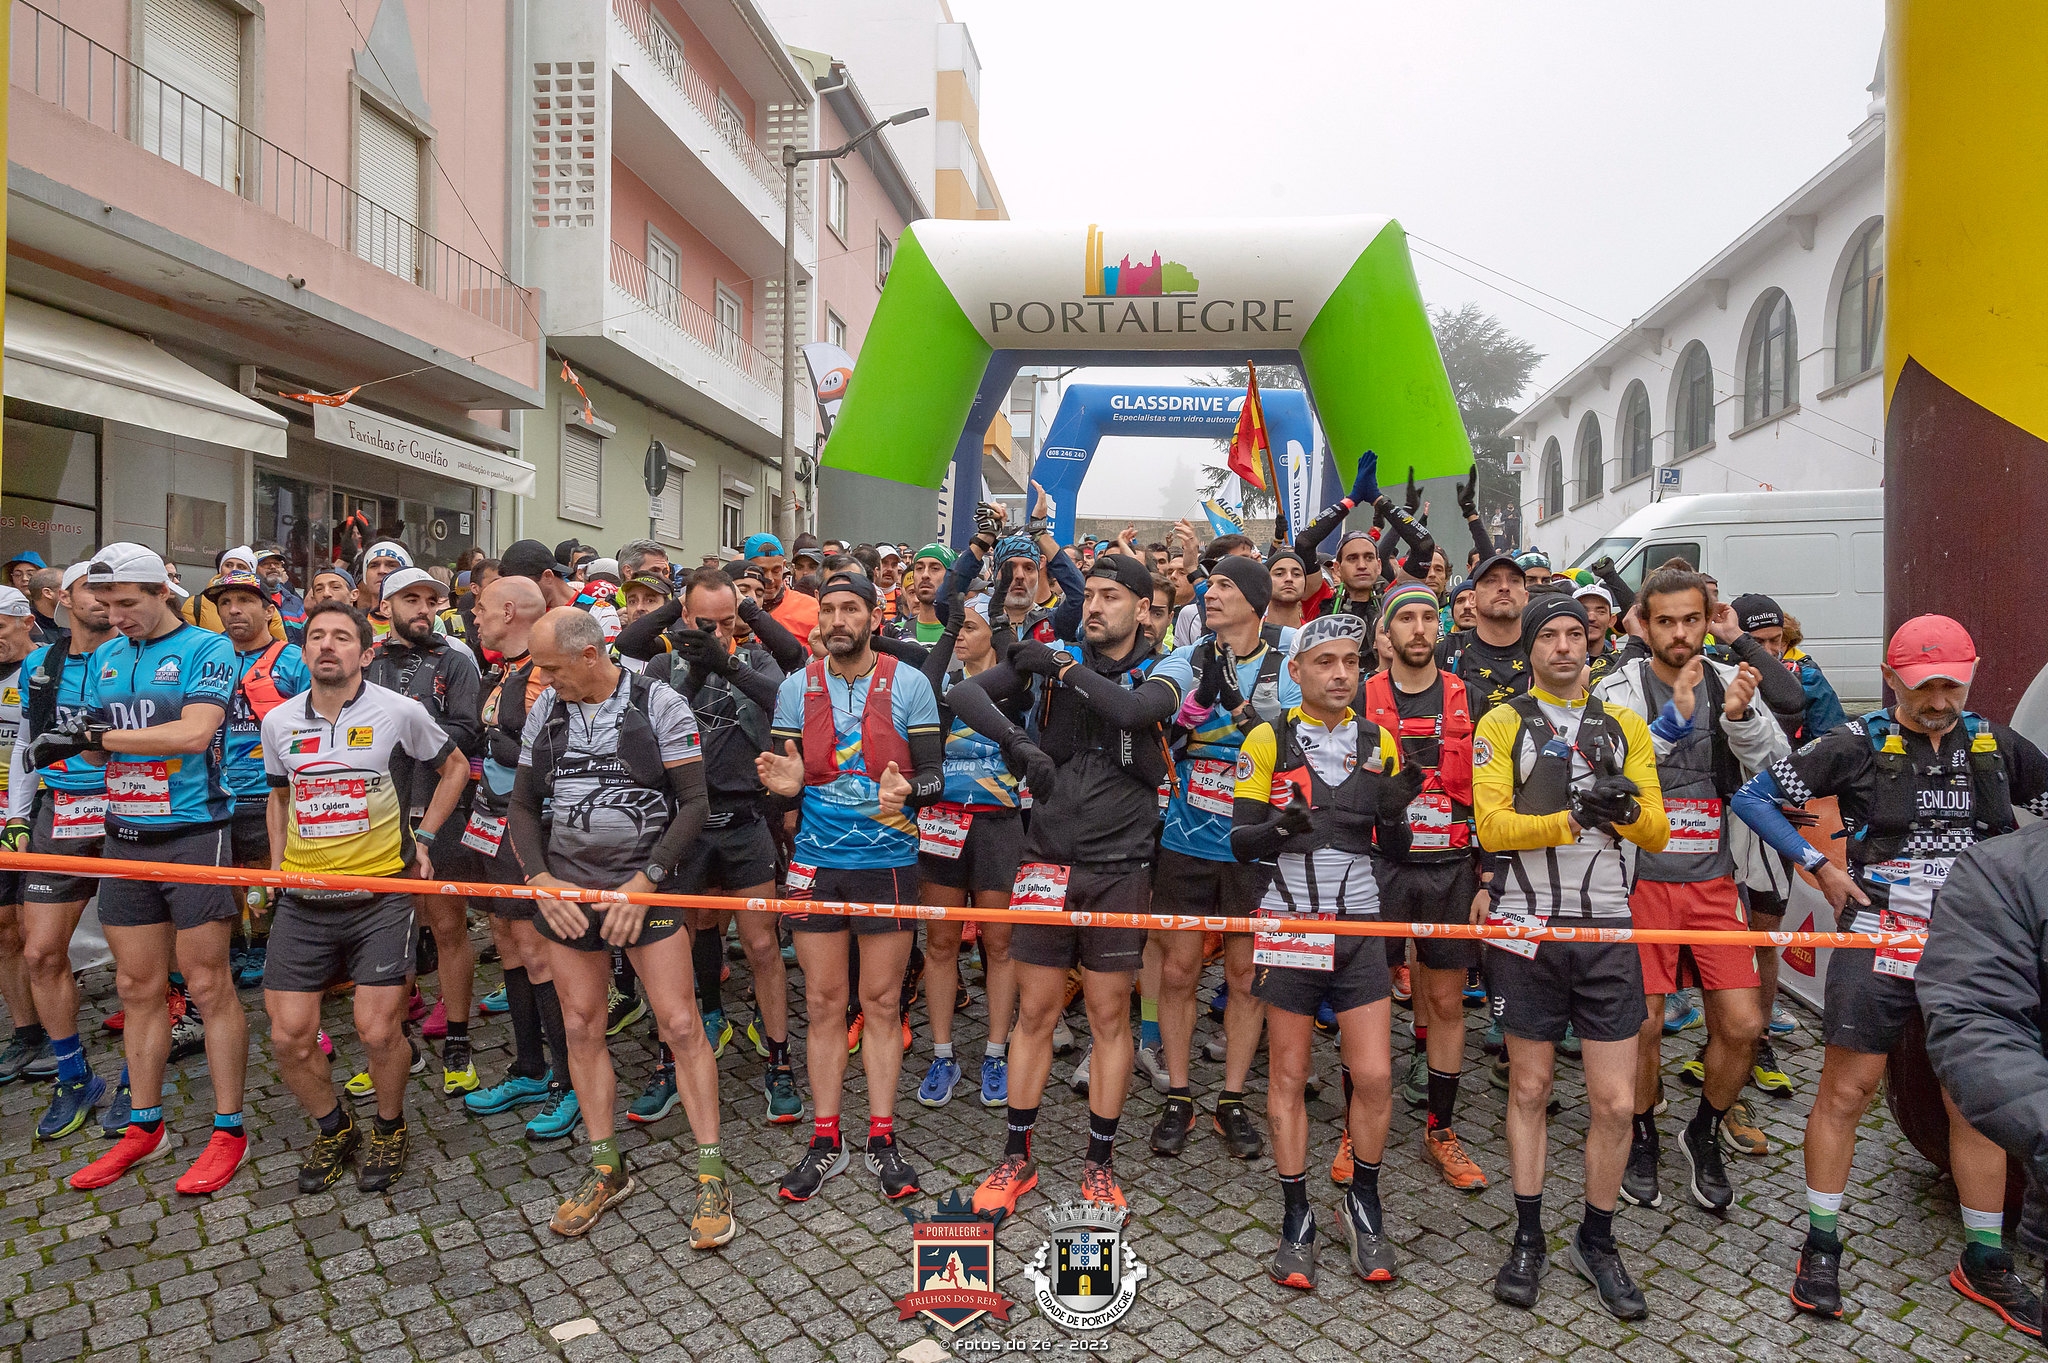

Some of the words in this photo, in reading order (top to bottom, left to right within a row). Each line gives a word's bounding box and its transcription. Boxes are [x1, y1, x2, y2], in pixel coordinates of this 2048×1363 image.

[989, 299, 1294, 334] PORTALEGRE
[1113, 413, 1166, 423] Especialistas
[1169, 415, 1181, 423] em
[1183, 414, 1204, 423] vidro
[348, 420, 395, 452] Farinhas
[397, 439, 407, 454] &
[20, 514, 83, 536] Regionais
[109, 700, 156, 730] DAP
[122, 781, 127, 789] 7
[128, 782, 146, 790] Paiva
[1201, 776, 1214, 787] 152
[74, 806, 79, 814] 8
[83, 806, 104, 814] Carita
[309, 803, 319, 812] 13
[322, 801, 350, 811] Caldera
[1410, 812, 1427, 821] Silva
[1680, 818, 1706, 827] Martins
[924, 822, 935, 831] 124
[937, 825, 958, 836] Pascoal
[1027, 884, 1051, 893] Galhofo
[302, 890, 359, 900] SALOMON
